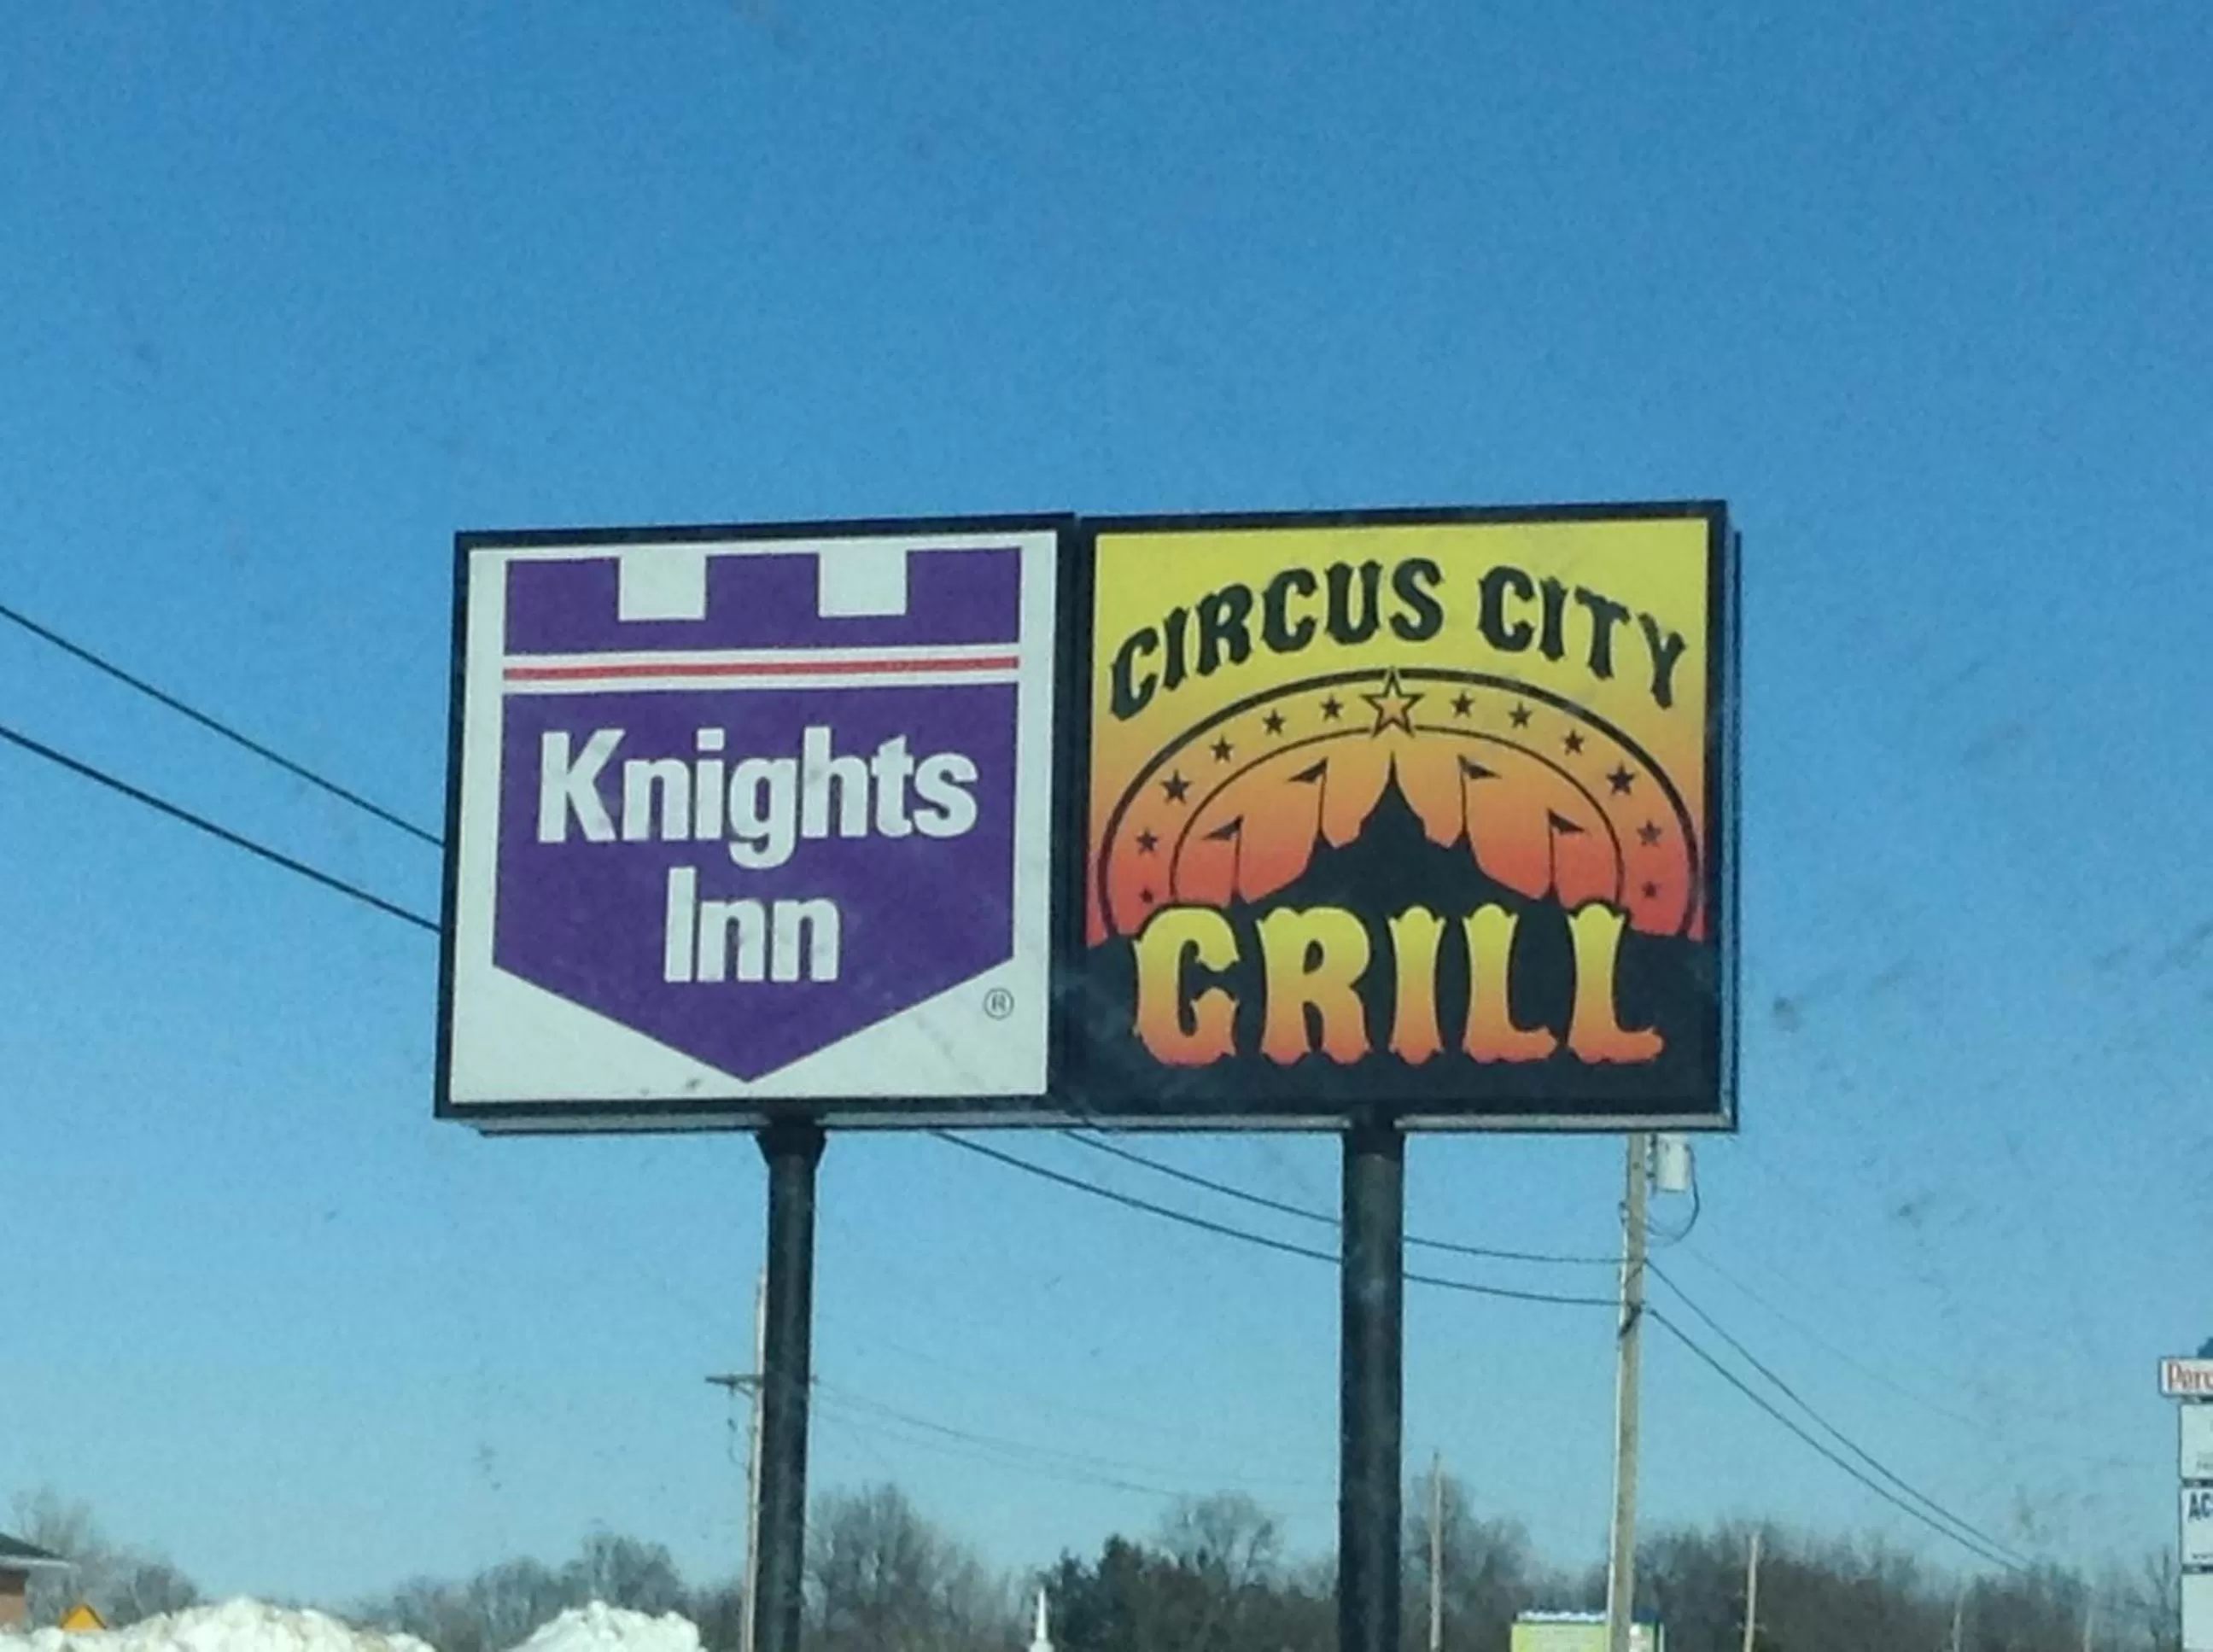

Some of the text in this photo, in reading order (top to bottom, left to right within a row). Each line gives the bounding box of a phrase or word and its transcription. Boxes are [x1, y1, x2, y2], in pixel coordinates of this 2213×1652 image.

[1109, 557, 1687, 721] CIRCUS CITY
[537, 727, 978, 869] Knights
[663, 866, 841, 984] Inn
[1132, 902, 1666, 1065] GRILL
